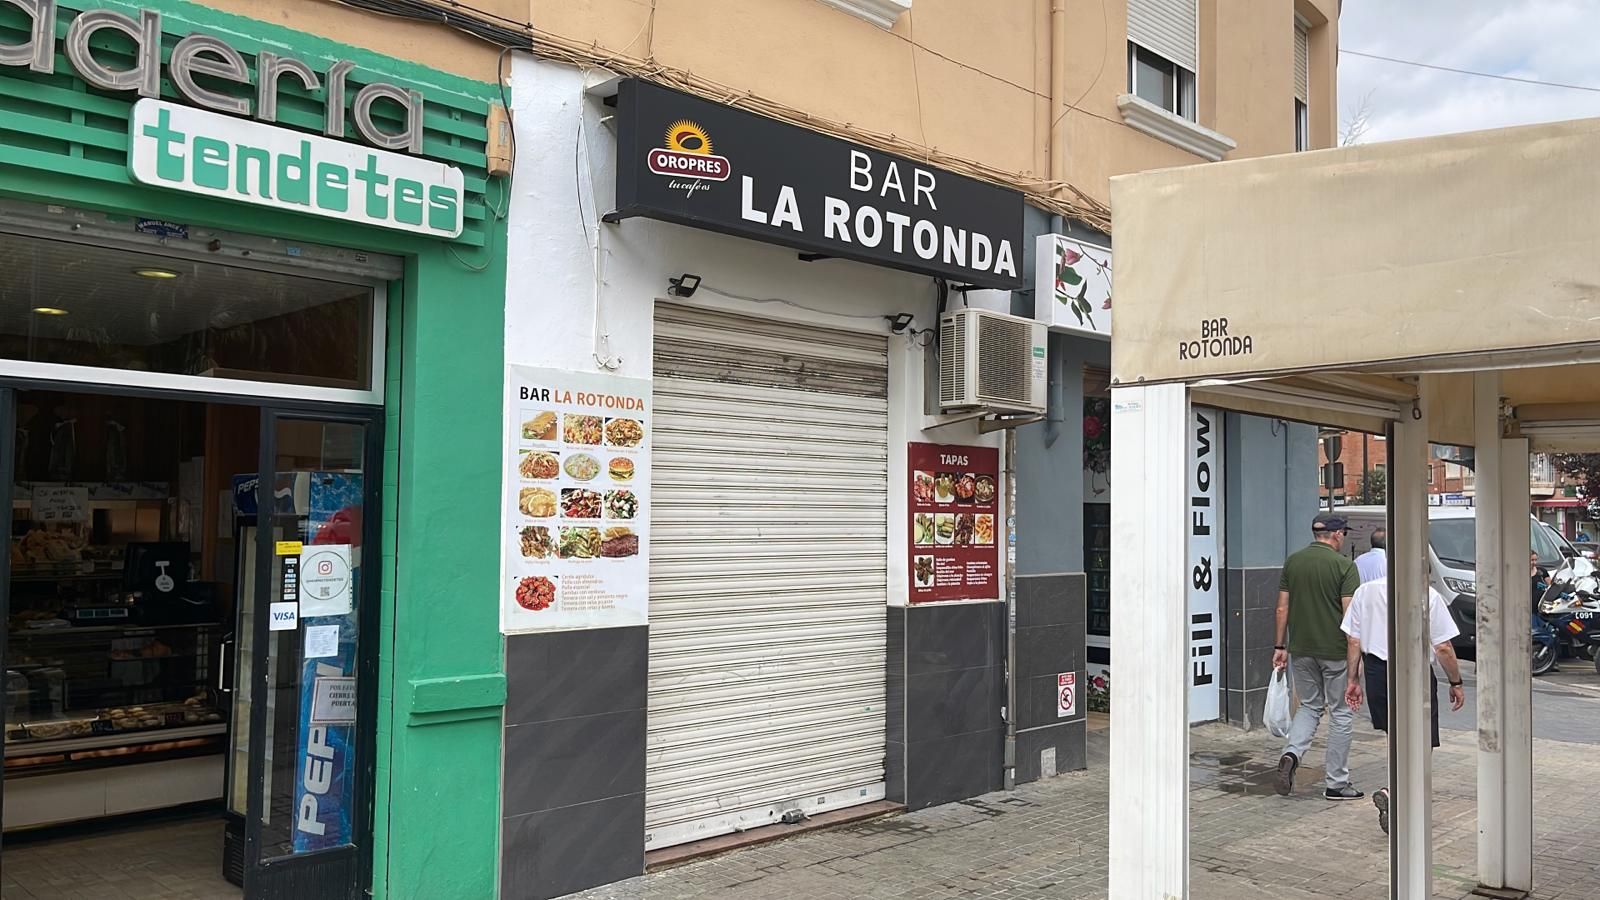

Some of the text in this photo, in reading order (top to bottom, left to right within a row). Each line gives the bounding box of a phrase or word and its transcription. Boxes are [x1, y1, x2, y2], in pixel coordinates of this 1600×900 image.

[143, 108, 458, 232] tendetes
[657, 154, 721, 173] OROPRES
[850, 149, 938, 211] BAR
[741, 175, 1017, 278] LA ROTONDA
[1201, 317, 1228, 339] BAR
[1179, 335, 1253, 360] ROTONDA
[519, 386, 645, 411] BAR LA ROTONDA
[940, 454, 969, 466] TAPAS
[1191, 413, 1213, 687] Fill & Flow
[273, 612, 295, 621] VISA
[297, 661, 344, 836] PEPI
